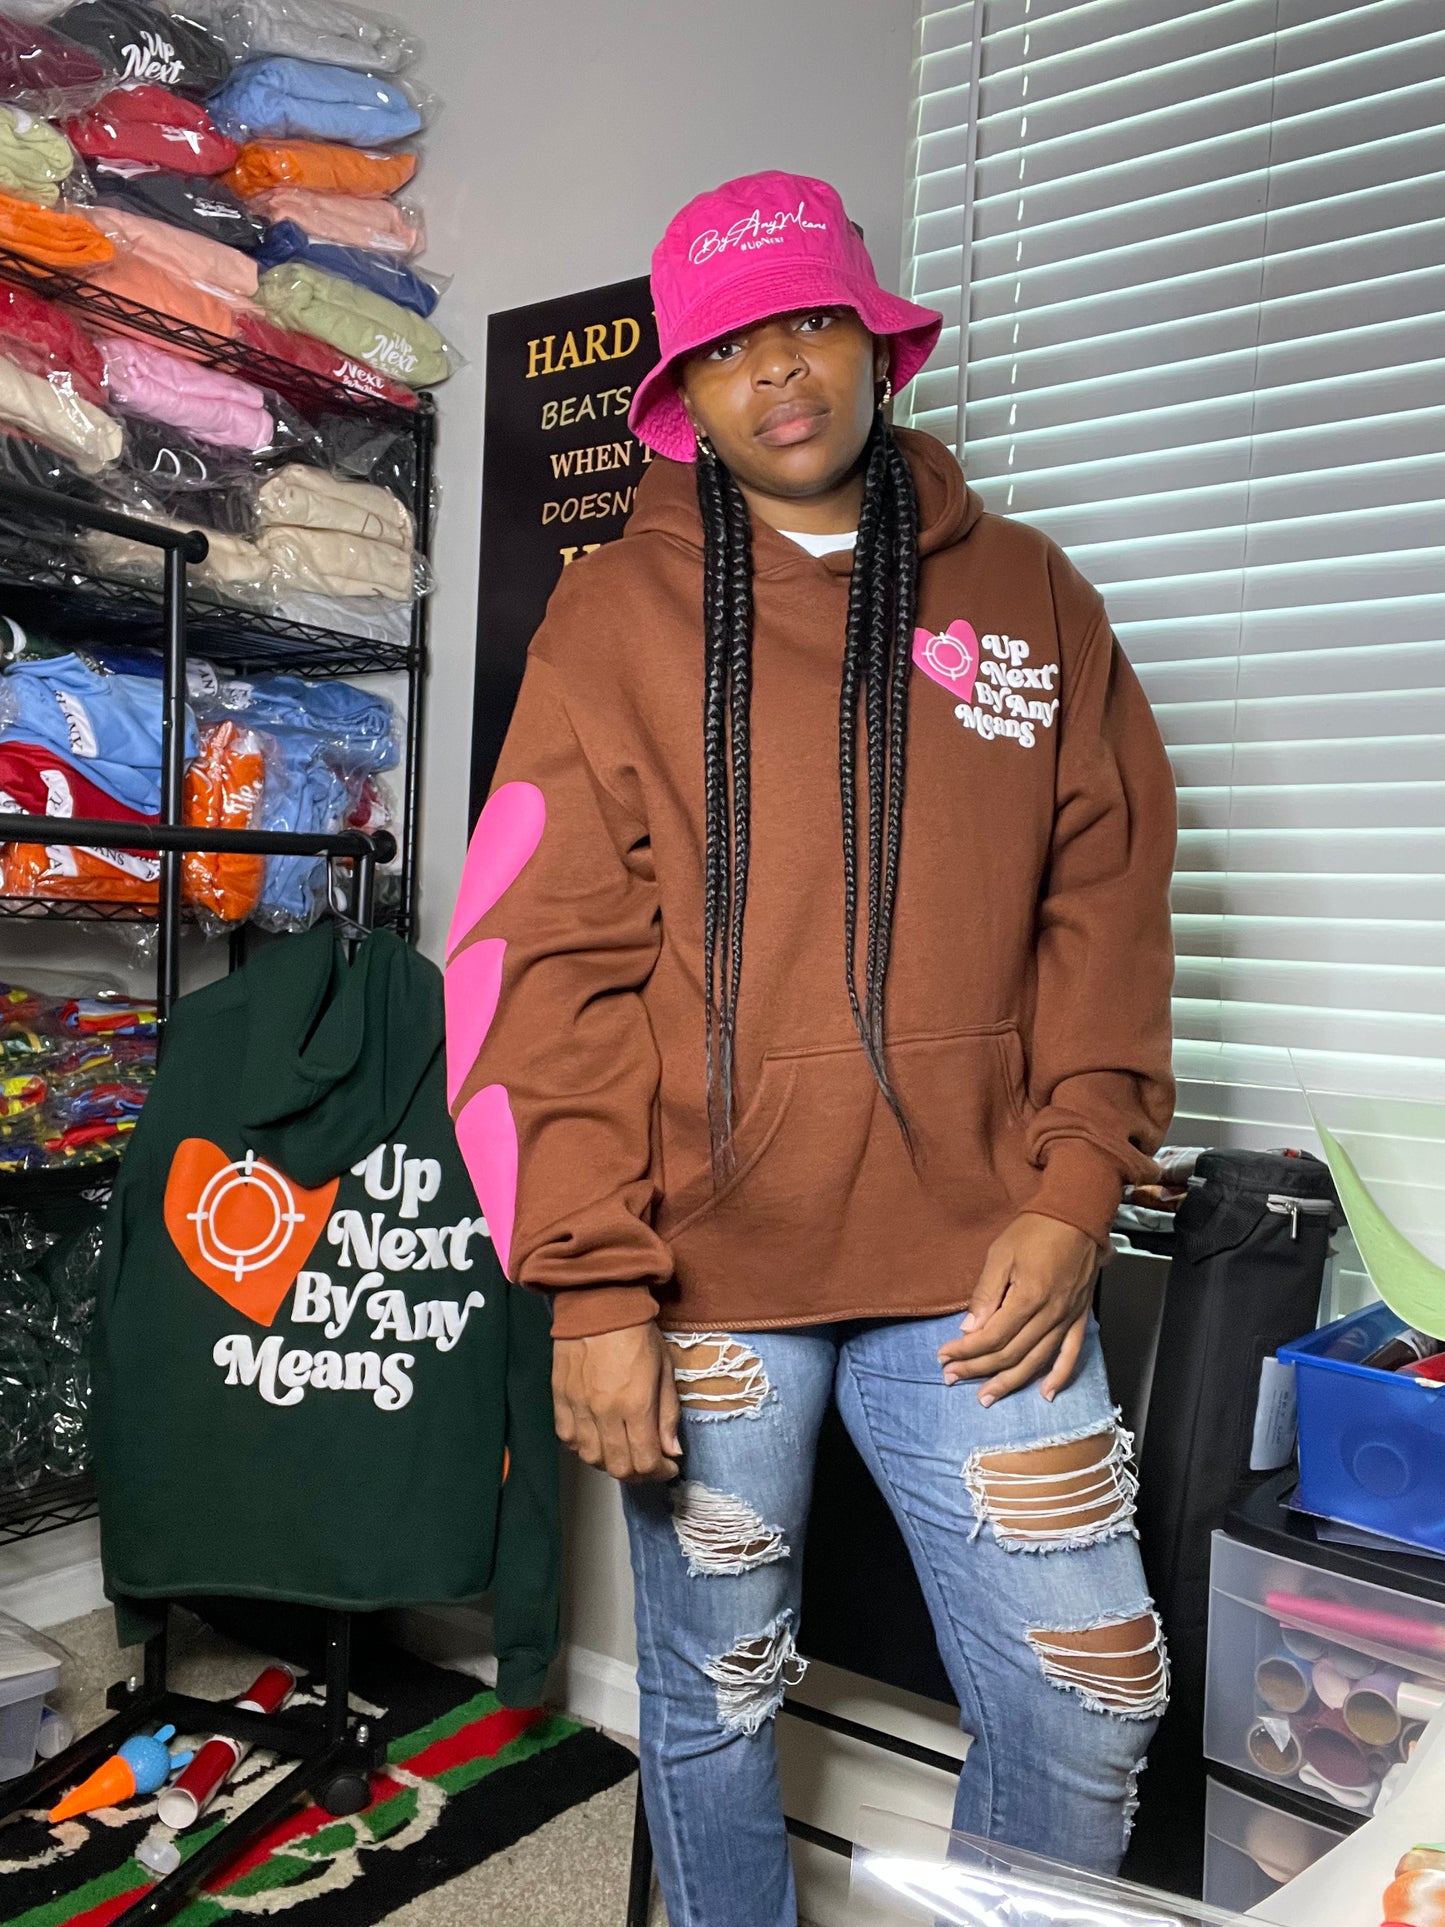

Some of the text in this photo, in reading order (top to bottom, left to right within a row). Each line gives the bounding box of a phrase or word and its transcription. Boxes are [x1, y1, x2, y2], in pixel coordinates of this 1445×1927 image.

[119, 43, 186, 85] Next
[139, 30, 175, 63] Up
[361, 334, 418, 373] Next
[525, 317, 641, 378] HARD
[332, 360, 385, 389] Next
[541, 386, 632, 430] BEATS
[550, 440, 634, 479] WHEN
[541, 486, 637, 525] DOESN'
[980, 634, 1030, 667] Up
[979, 660, 1059, 690] Next
[954, 703, 1036, 748] Means
[974, 681, 1060, 728] By Any
[351, 1143, 442, 1218] Up
[327, 1209, 491, 1271] Next
[290, 1271, 486, 1352] By Any
[213, 1334, 415, 1411] Means
